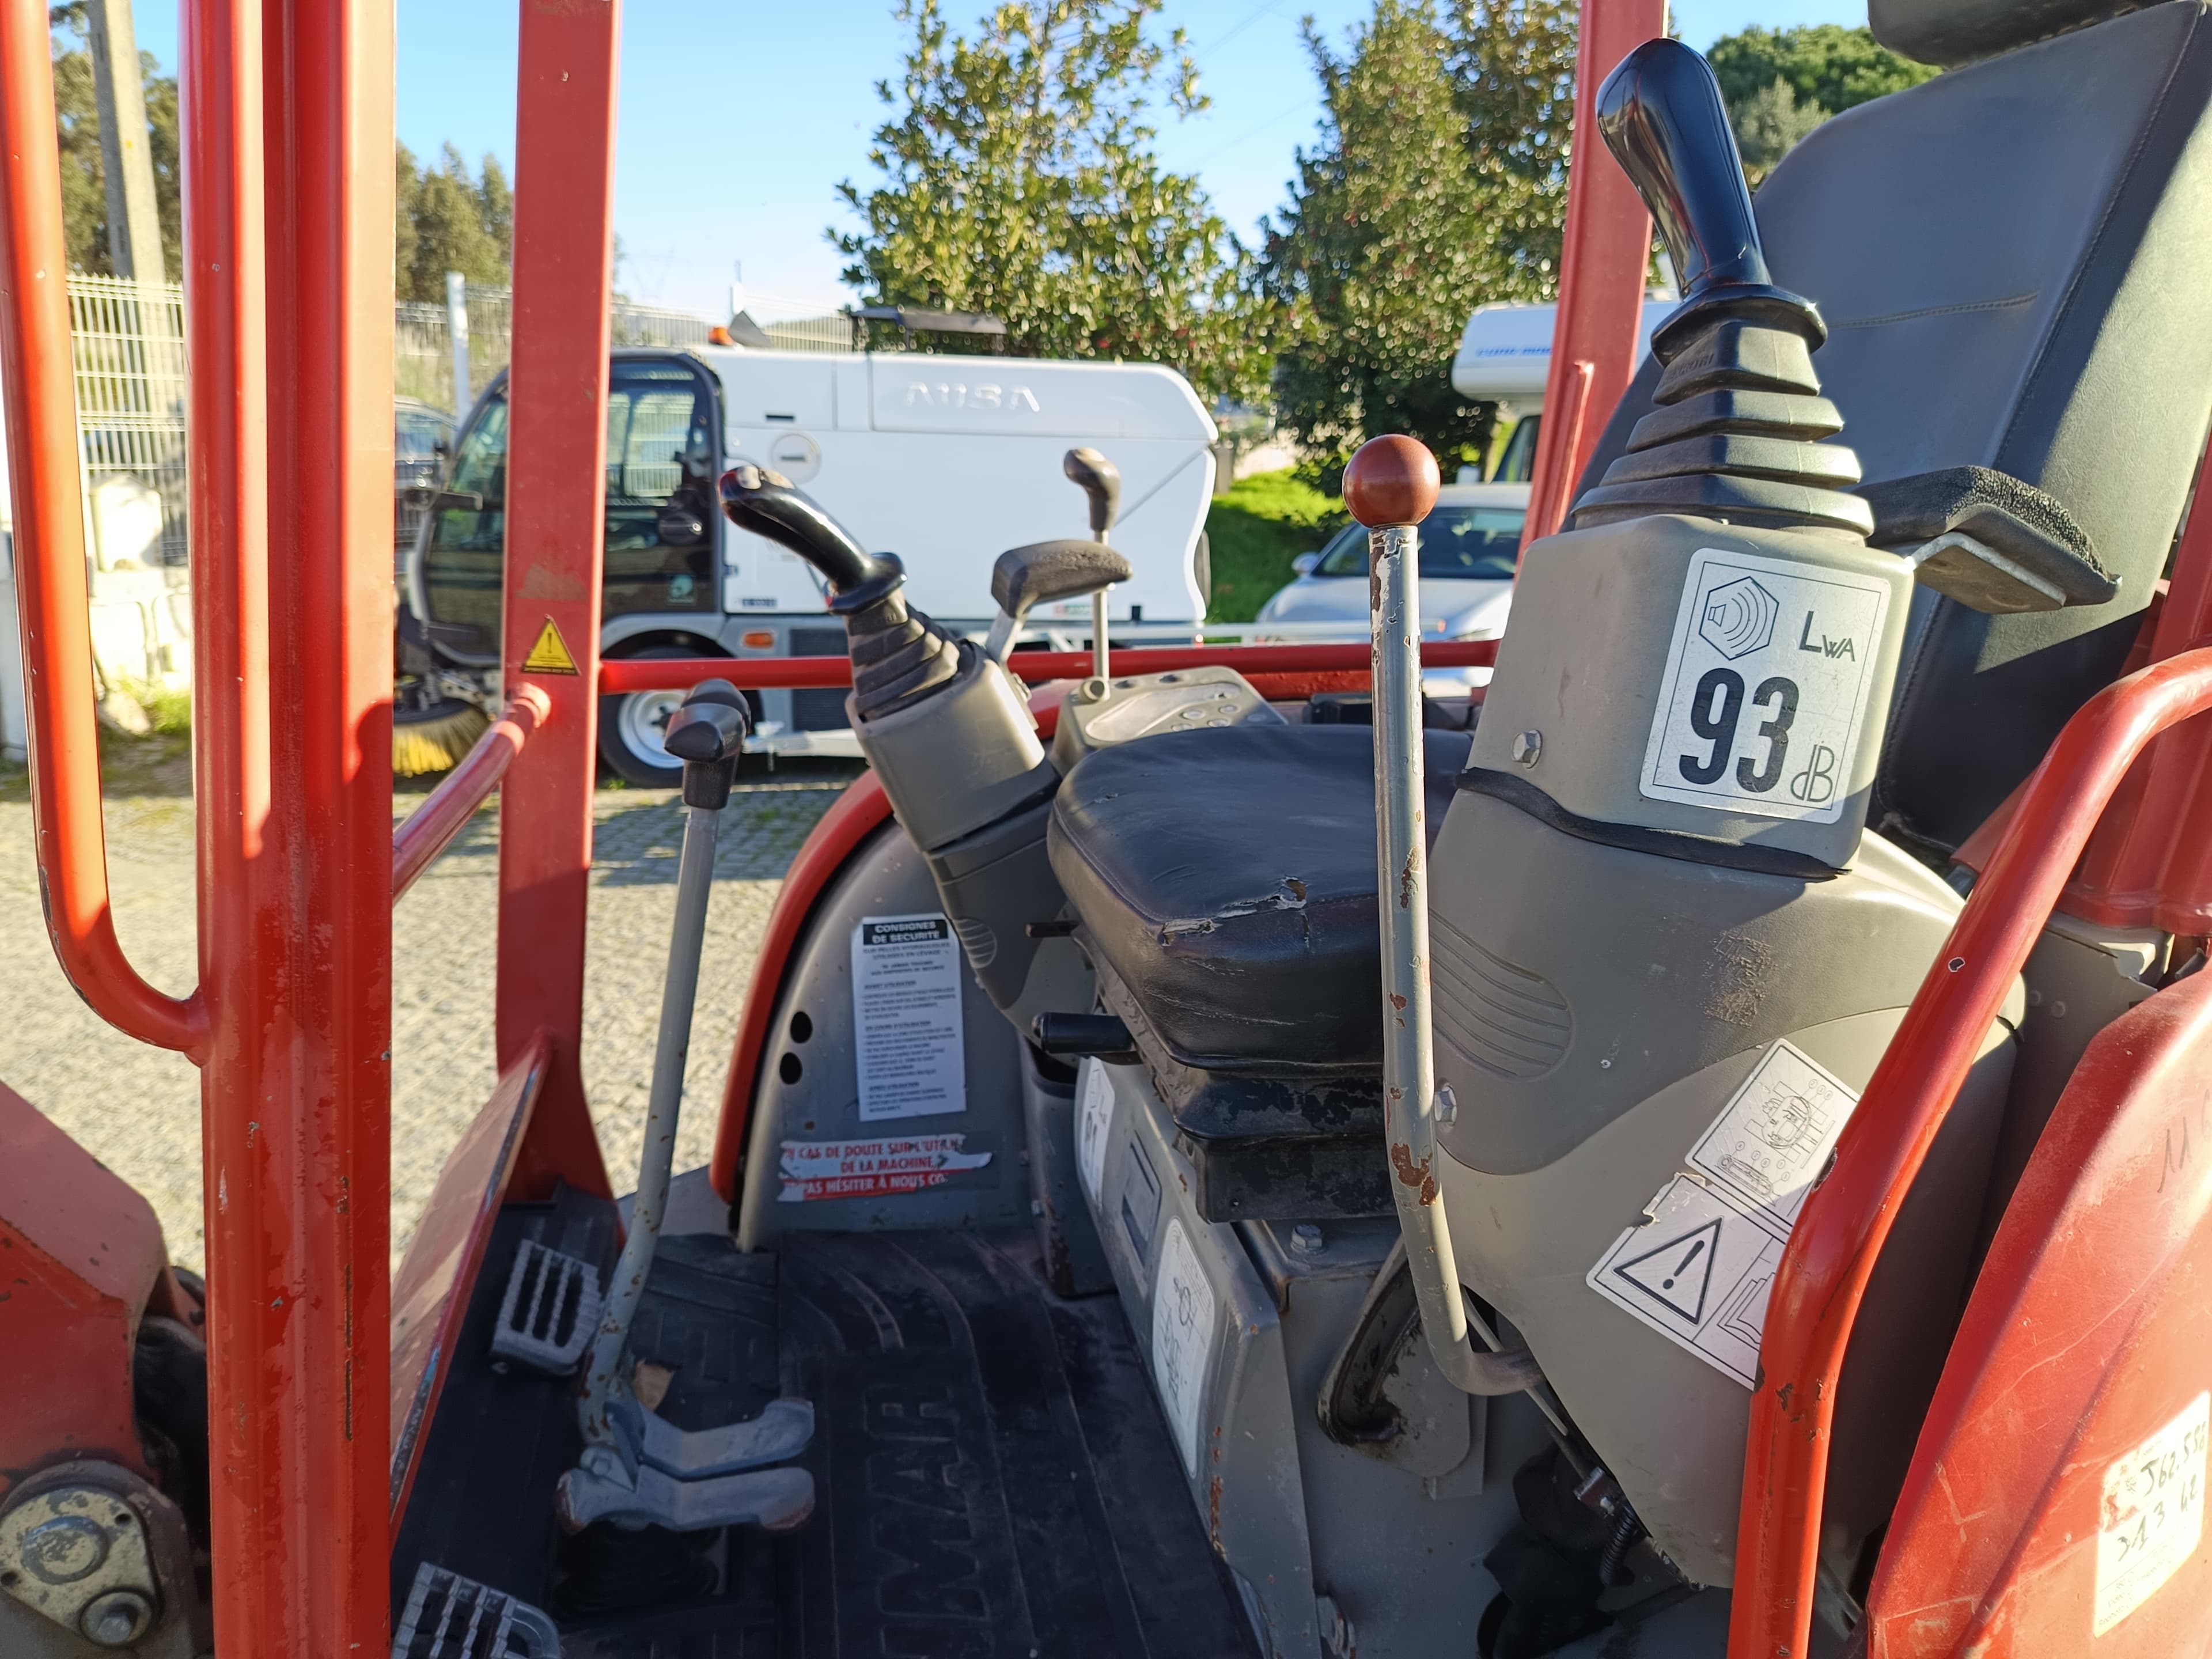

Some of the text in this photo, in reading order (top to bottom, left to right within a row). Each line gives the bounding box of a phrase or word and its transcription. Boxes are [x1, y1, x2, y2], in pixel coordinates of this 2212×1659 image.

[904, 382, 1040, 412] AUSA
[1679, 668, 1835, 802] 93 dB
[874, 921, 936, 933] CONSIGNES
[872, 934, 888, 944] DE
[799, 1146, 821, 1160] CAS
[825, 1145, 839, 1158] DE
[844, 1142, 882, 1157] DOUTE
[888, 1140, 911, 1153] SUR
[841, 1160, 854, 1173] DE
[860, 1160, 874, 1172] LA
[803, 1180, 823, 1195] PAS
[889, 1173, 926, 1190] NOUS
